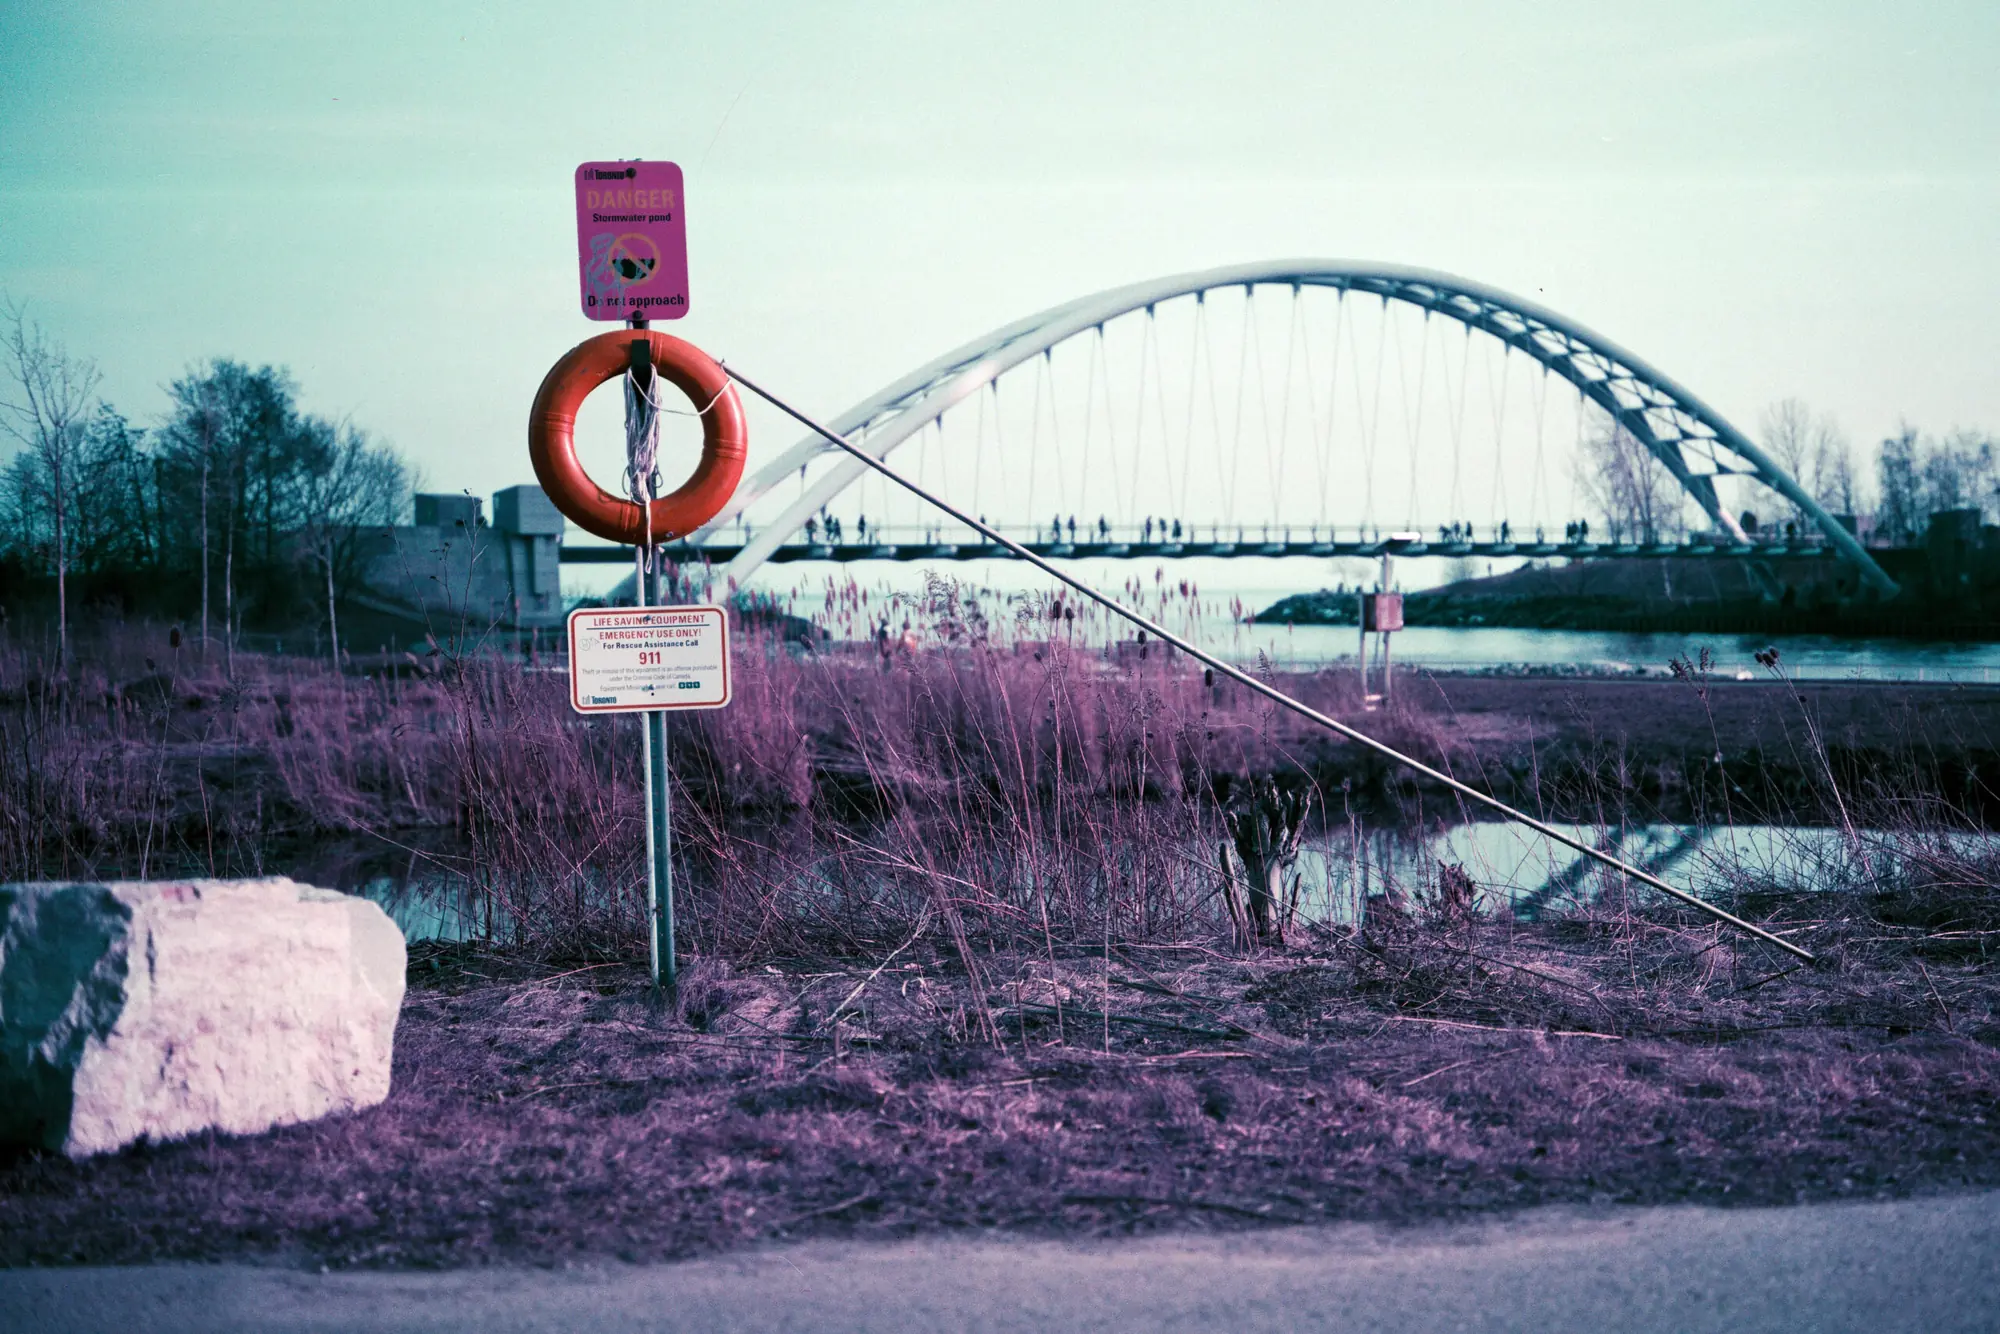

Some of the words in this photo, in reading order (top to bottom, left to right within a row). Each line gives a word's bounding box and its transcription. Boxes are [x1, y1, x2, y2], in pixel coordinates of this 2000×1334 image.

[587, 189, 675, 209] DANGER
[592, 213, 646, 222] Stormwater
[648, 212, 671, 224] pond
[588, 295, 604, 306] D
[629, 294, 684, 308] approach
[594, 617, 612, 626] LIFE
[614, 616, 649, 626] SAVING
[652, 614, 705, 624] EQUIPMENT
[600, 630, 654, 640] EMERGENCY
[656, 630, 674, 638] USE
[676, 628, 702, 638] ONLY!
[644, 640, 684, 648] Assistance
[639, 652, 661, 665] 911
[591, 696, 617, 704] TORONTO
